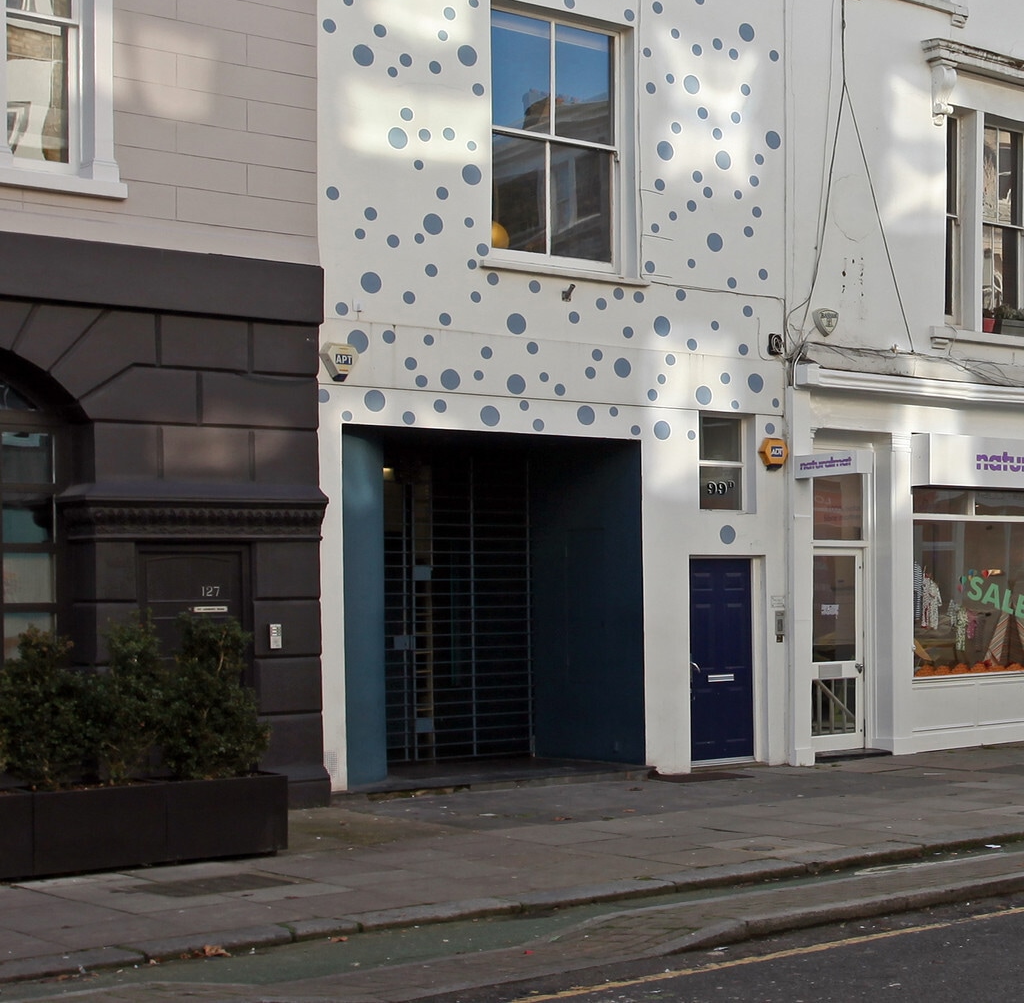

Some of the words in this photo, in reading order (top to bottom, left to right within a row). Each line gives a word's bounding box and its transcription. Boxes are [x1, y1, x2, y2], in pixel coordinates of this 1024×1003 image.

[336, 354, 352, 364] APT
[771, 448, 783, 456] ADT
[800, 456, 852, 471] naturalmat
[201, 586, 220, 597] 127
